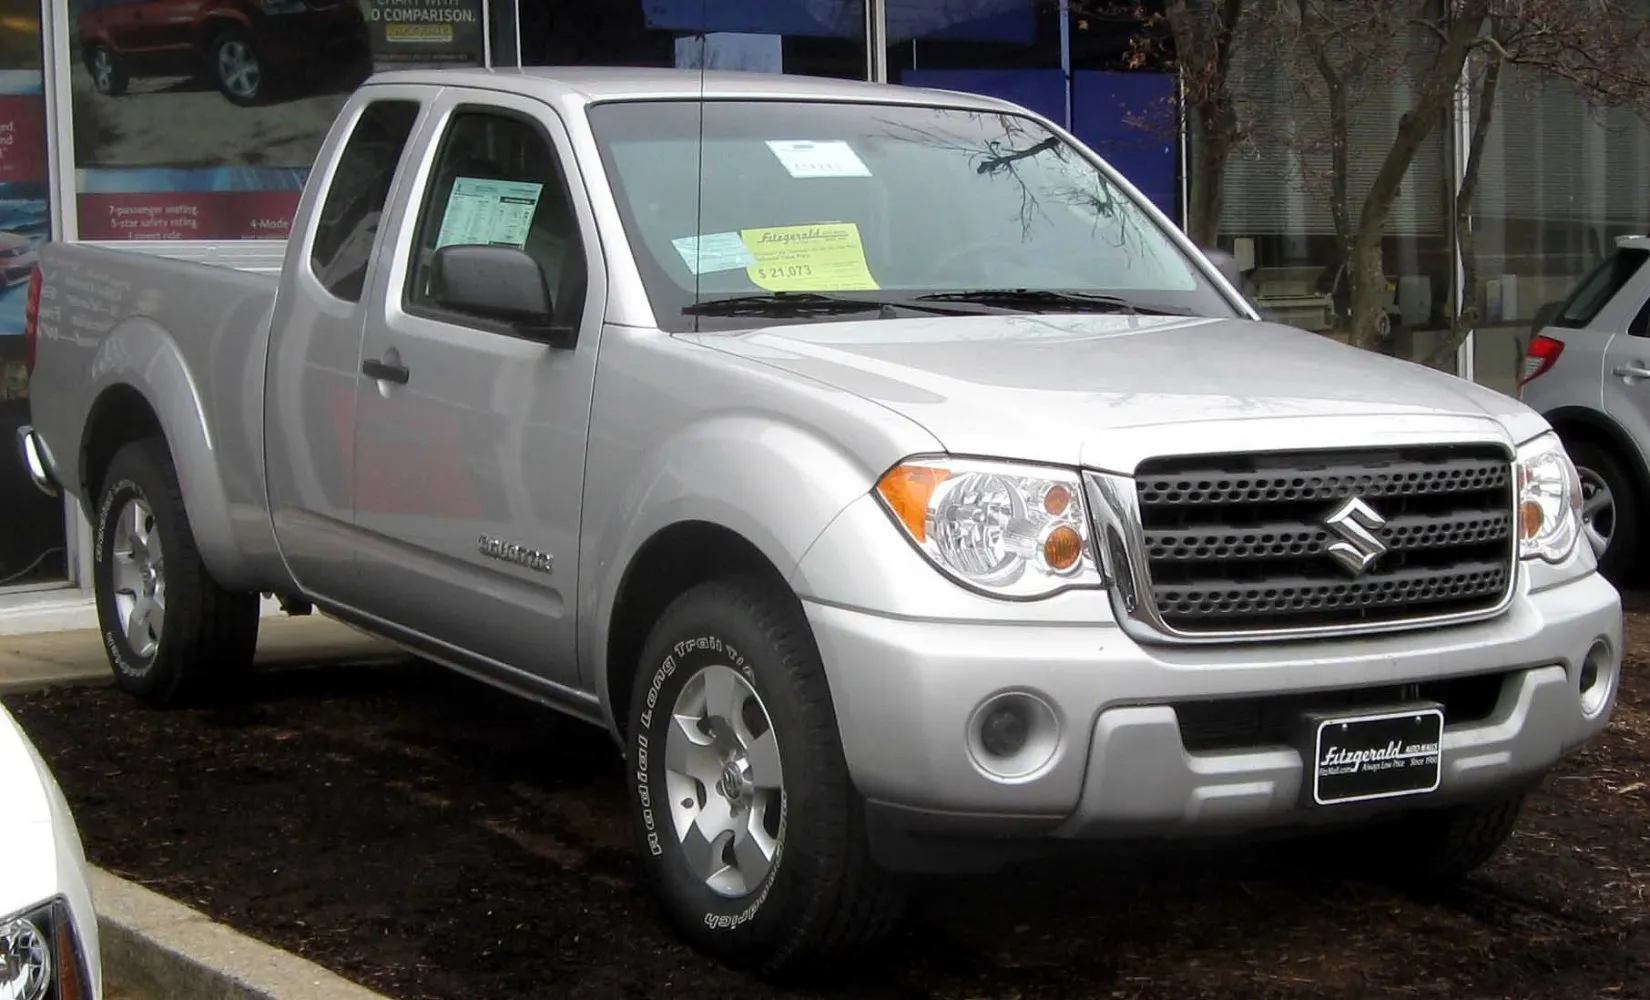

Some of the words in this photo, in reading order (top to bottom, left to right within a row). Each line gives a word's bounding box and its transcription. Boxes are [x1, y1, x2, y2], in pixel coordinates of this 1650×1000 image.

[383, 7, 477, 22] COMPARISON.
[757, 228, 821, 245] Fitzgerald
[758, 268, 767, 279] $
[770, 264, 812, 279] 21,073
[673, 636, 723, 657] Trail
[640, 655, 677, 729] Long
[1320, 740, 1403, 773] Fitzgerald
[637, 734, 663, 857] Radial
